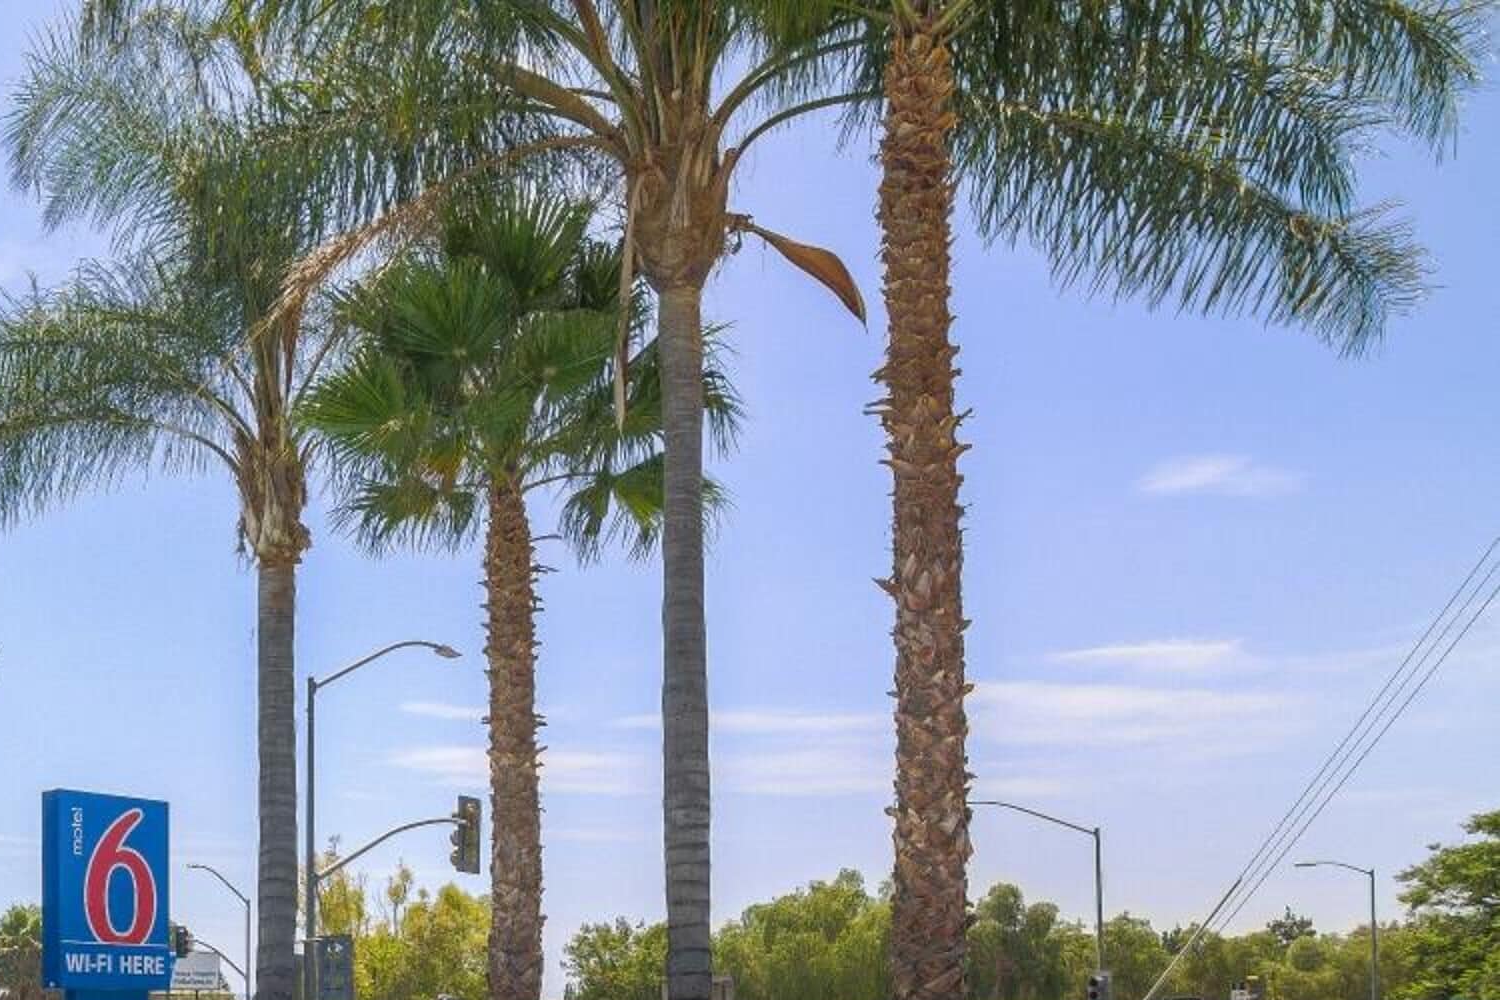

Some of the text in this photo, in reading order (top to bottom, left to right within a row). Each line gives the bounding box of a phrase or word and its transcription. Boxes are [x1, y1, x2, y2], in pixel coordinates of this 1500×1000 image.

[71, 806, 84, 856] motel
[84, 807, 157, 945] 6
[66, 953, 165, 976] WI-FI HERE
